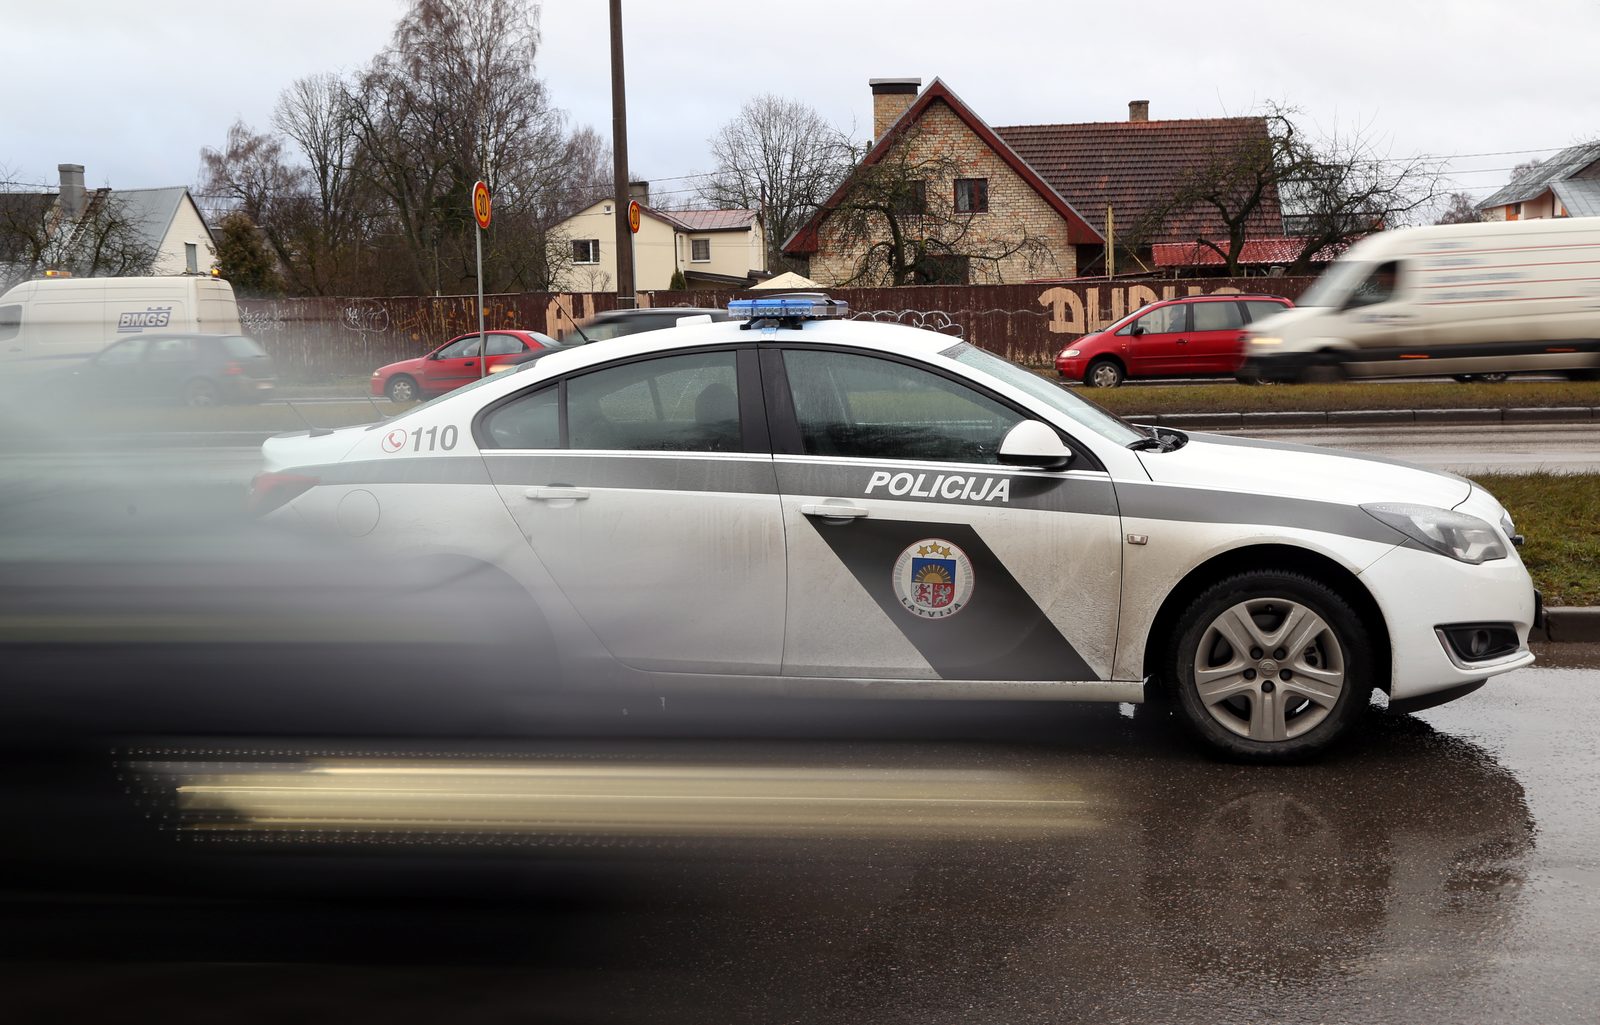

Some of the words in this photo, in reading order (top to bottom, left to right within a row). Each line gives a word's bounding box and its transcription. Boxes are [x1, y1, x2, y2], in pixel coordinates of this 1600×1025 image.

[478, 193, 487, 217] 30
[120, 313, 169, 328] BMGS
[411, 425, 458, 451] 110
[864, 471, 1010, 502] POLICIJA
[901, 597, 962, 617] LATVIJA
